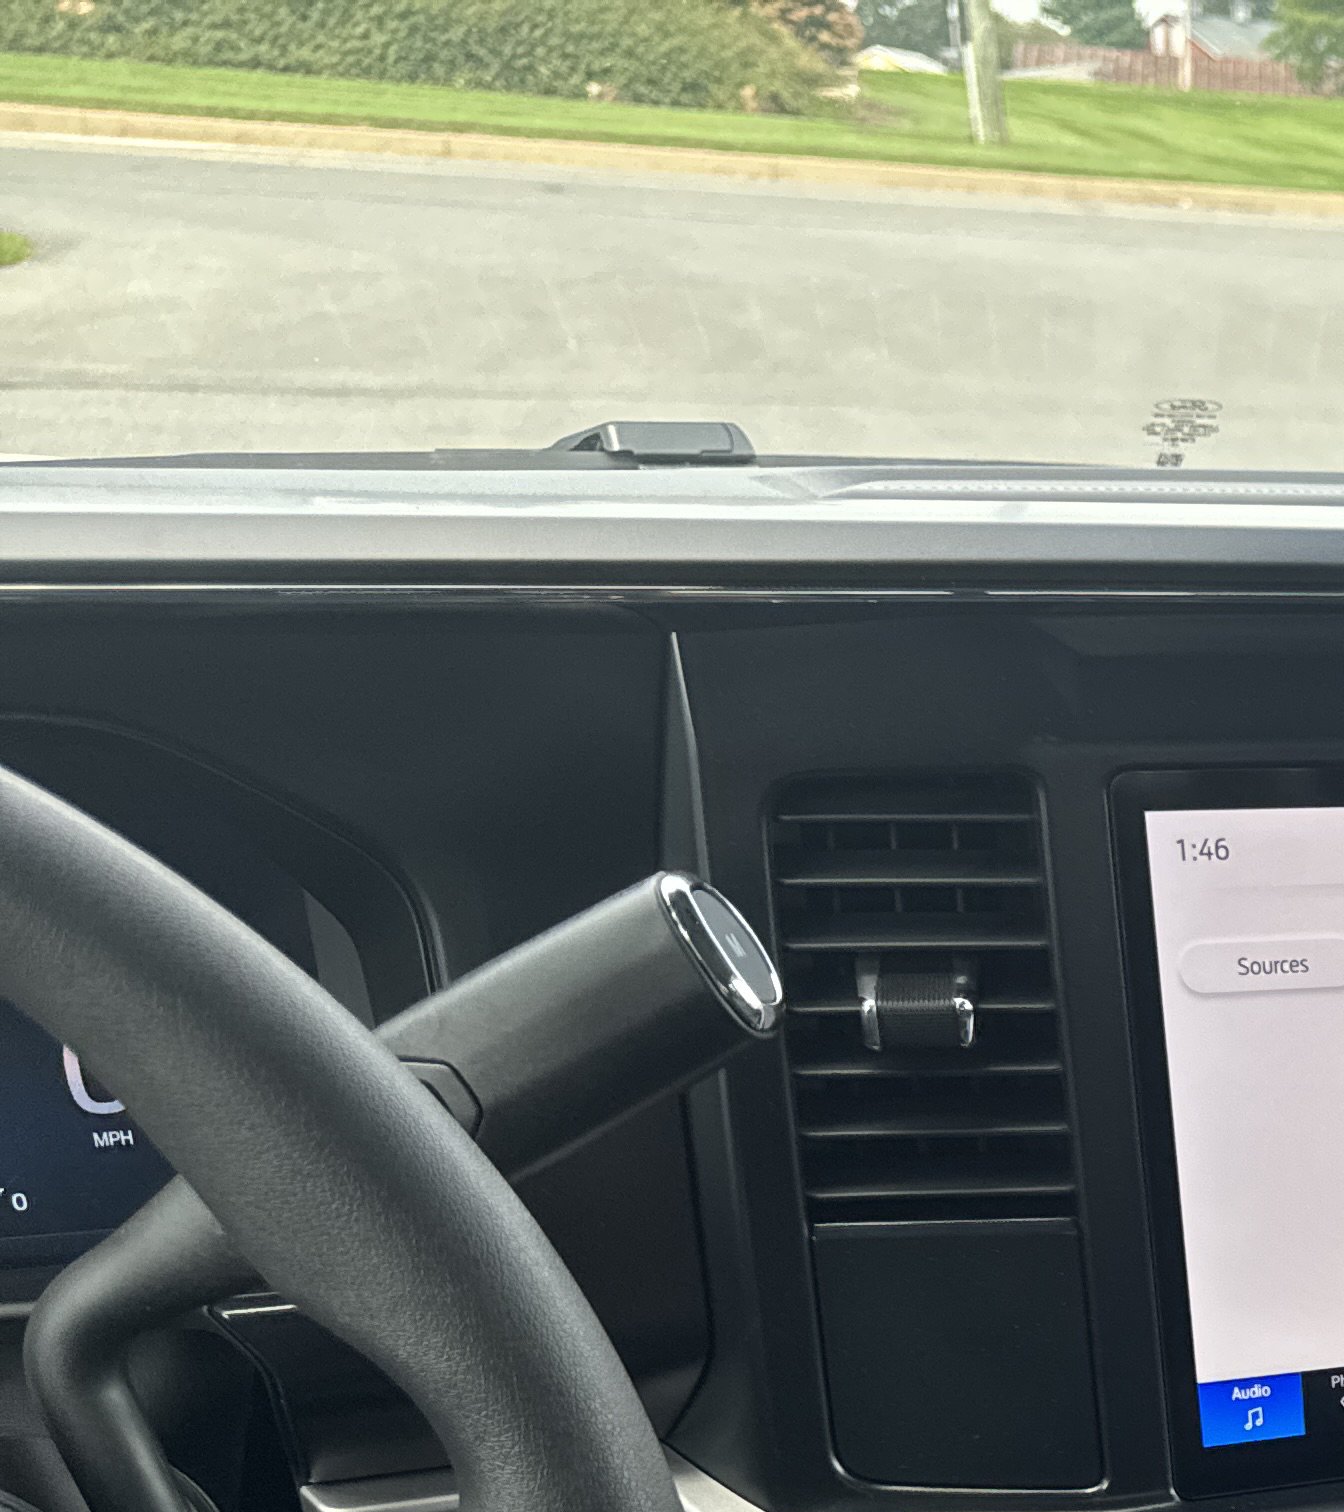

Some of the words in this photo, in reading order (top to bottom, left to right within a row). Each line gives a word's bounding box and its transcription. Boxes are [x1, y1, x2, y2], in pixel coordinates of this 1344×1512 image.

[1175, 837, 1231, 862] 1:46
[1237, 956, 1310, 976] Sources
[92, 1129, 134, 1148] MPH
[1231, 1384, 1271, 1401] Audio
